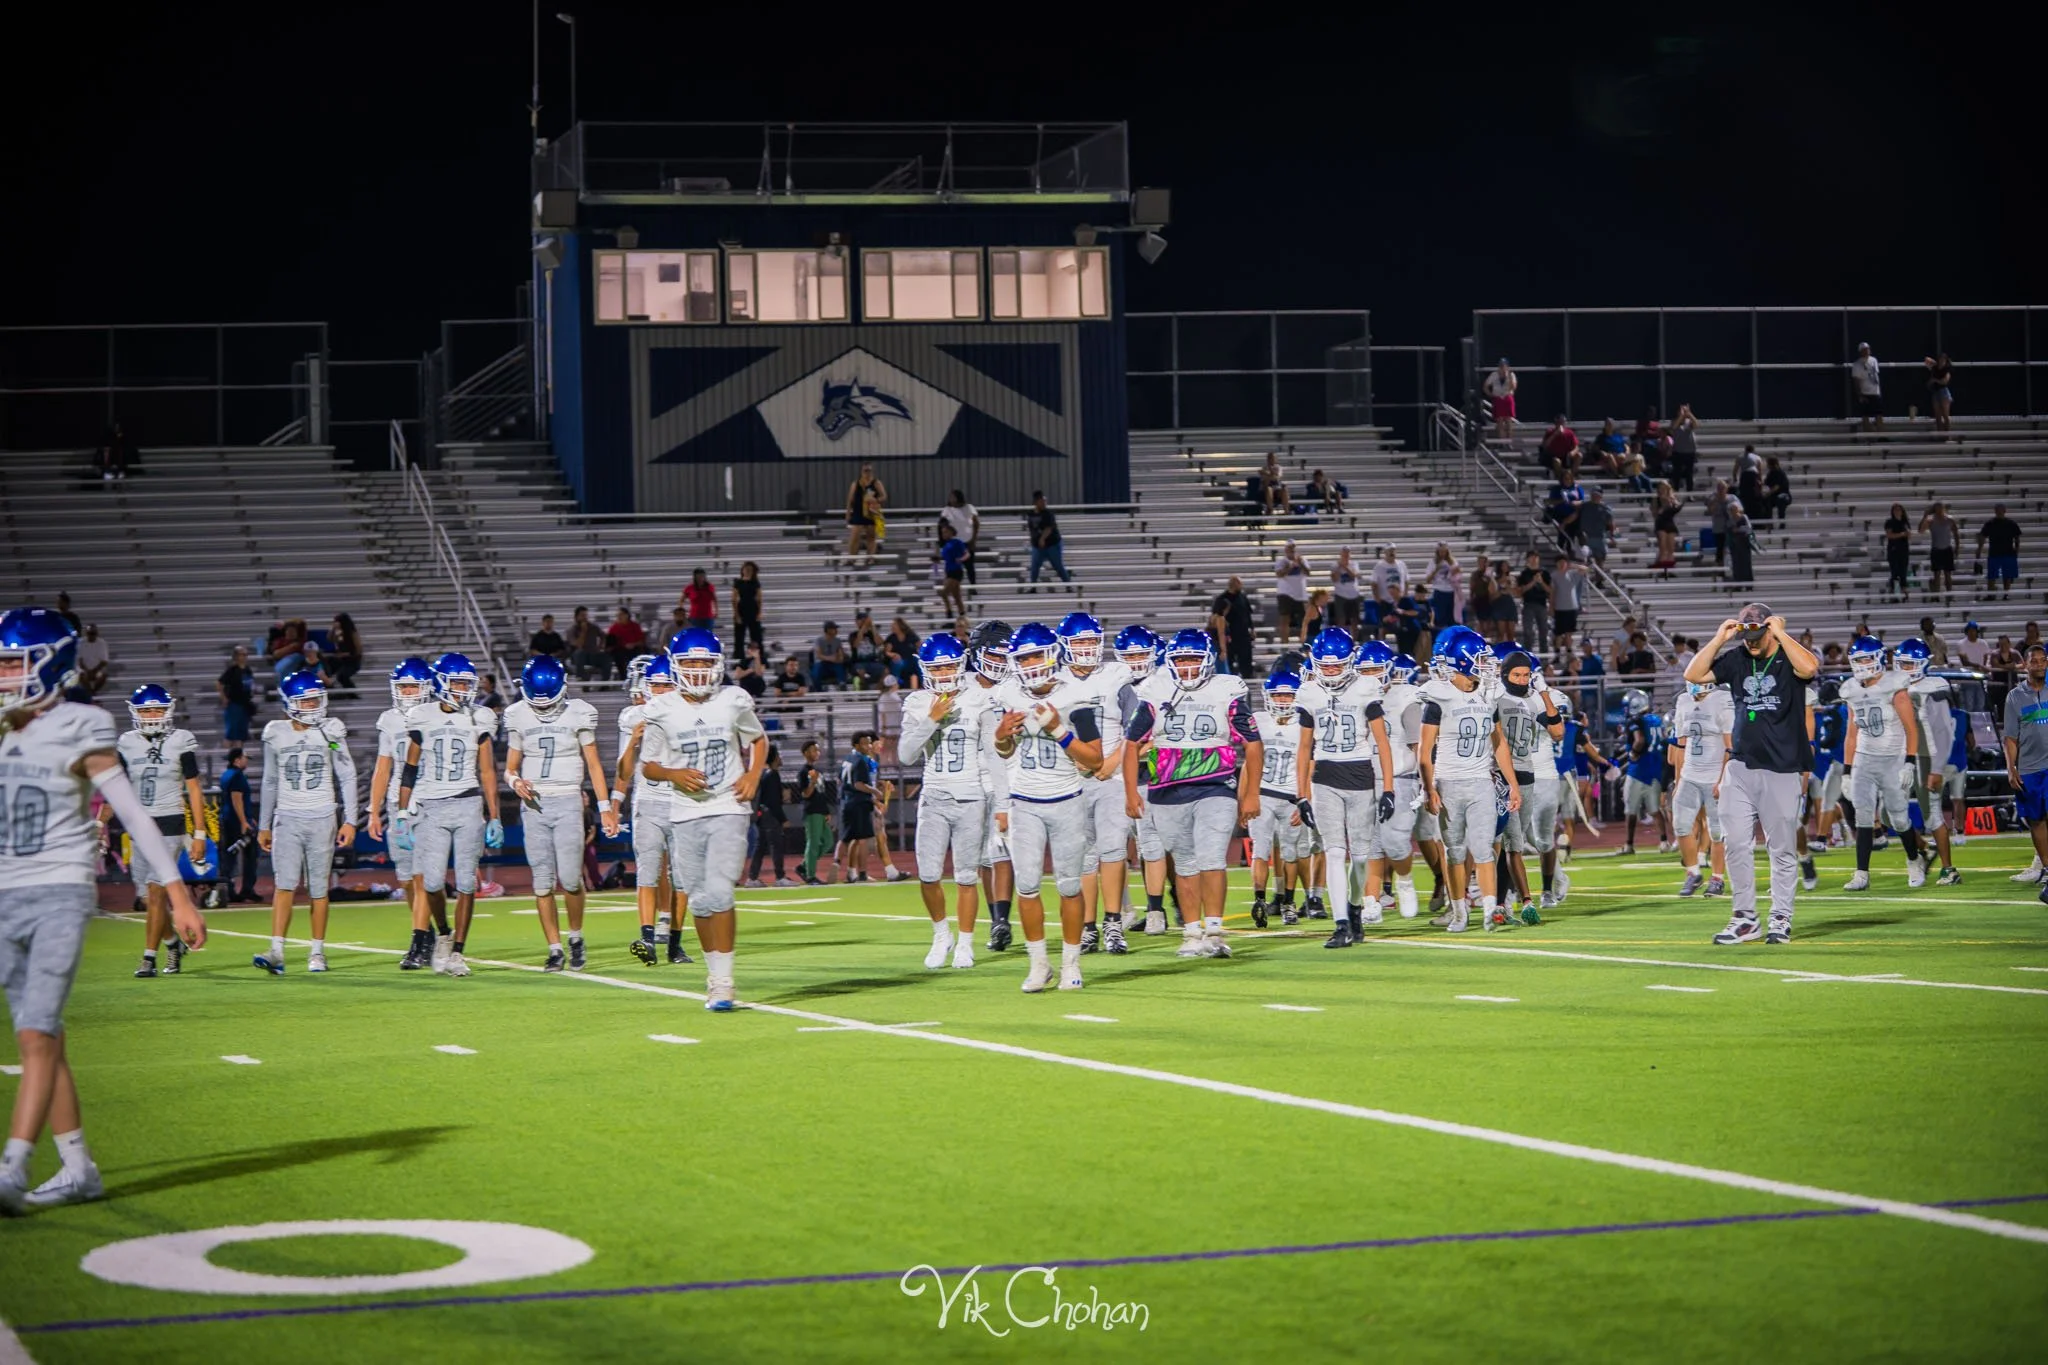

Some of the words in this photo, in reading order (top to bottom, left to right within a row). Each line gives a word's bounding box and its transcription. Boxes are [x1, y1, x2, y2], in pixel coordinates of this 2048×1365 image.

[933, 728, 966, 773] 19
[1318, 714, 1356, 753] 23
[1457, 716, 1491, 758] 81
[1506, 716, 1532, 757] 15
[1690, 721, 1703, 756] 2
[284, 753, 325, 791] 49
[432, 738, 466, 781] 13
[538, 736, 555, 778] 7
[1262, 747, 1292, 784] 91
[1973, 811, 1993, 831] 40
